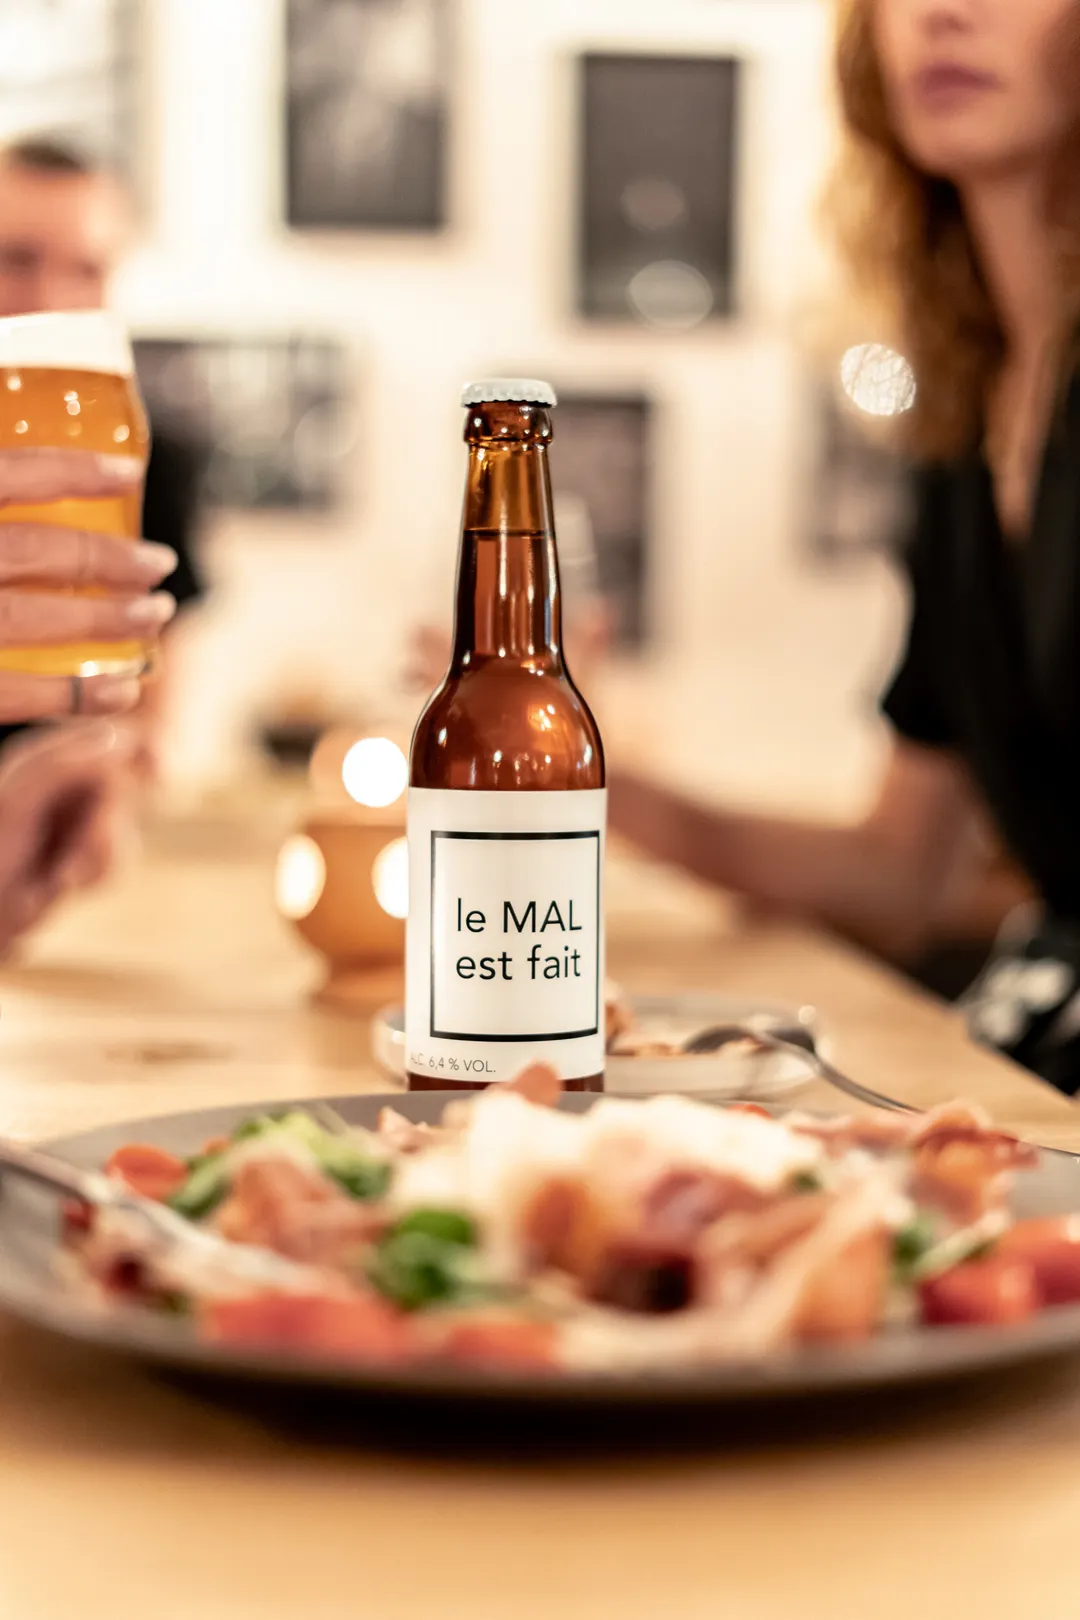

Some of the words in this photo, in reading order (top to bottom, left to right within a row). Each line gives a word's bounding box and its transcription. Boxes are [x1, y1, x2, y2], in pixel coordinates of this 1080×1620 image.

[457, 897, 487, 933] le
[503, 899, 583, 934] MAL
[456, 951, 513, 981] est
[526, 944, 582, 980] fait
[428, 1055, 445, 1070] 6,4
[447, 1057, 460, 1071] %
[462, 1059, 497, 1073] VOL.
